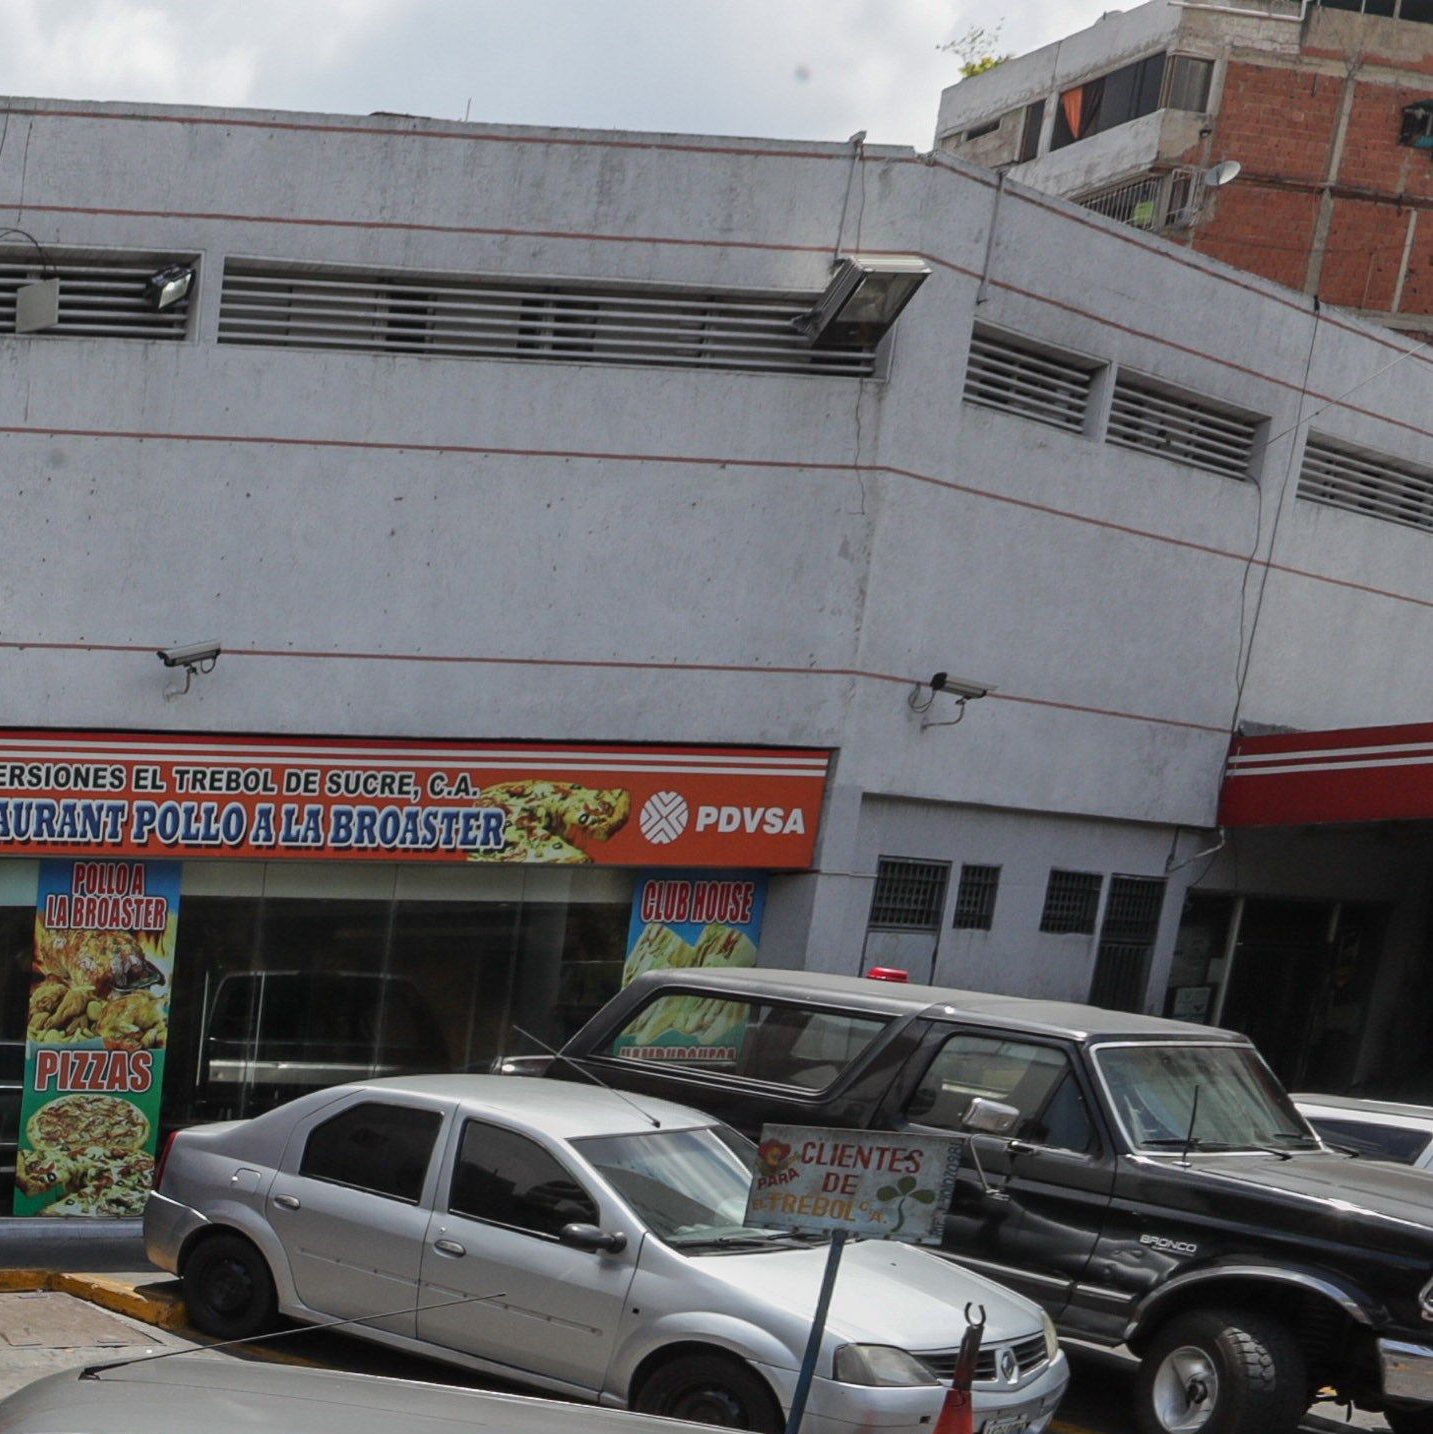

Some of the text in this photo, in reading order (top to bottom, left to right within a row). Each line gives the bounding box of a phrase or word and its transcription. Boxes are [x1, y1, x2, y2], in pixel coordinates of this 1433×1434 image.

[133, 765, 166, 792] EL
[174, 767, 277, 795] TREBOL
[285, 770, 320, 795] DE
[326, 771, 421, 802] SUCRE,
[428, 774, 480, 799] C.A.
[131, 798, 245, 843] POLLO
[250, 803, 274, 845] A
[280, 804, 324, 846] LA
[328, 804, 507, 850] BROASTER
[695, 805, 805, 835] PDVSA
[72, 862, 145, 896] POLLO A
[45, 896, 167, 930] LA BROASTER
[641, 880, 755, 923] CLUB HOUSE
[34, 1050, 152, 1093] PIZZAS
[800, 1141, 924, 1174] CLIENTES
[757, 1167, 800, 1190] PARA
[822, 1172, 859, 1195] DE
[768, 1193, 856, 1222] TREBOL
[1139, 1234, 1197, 1252] BRONCO
